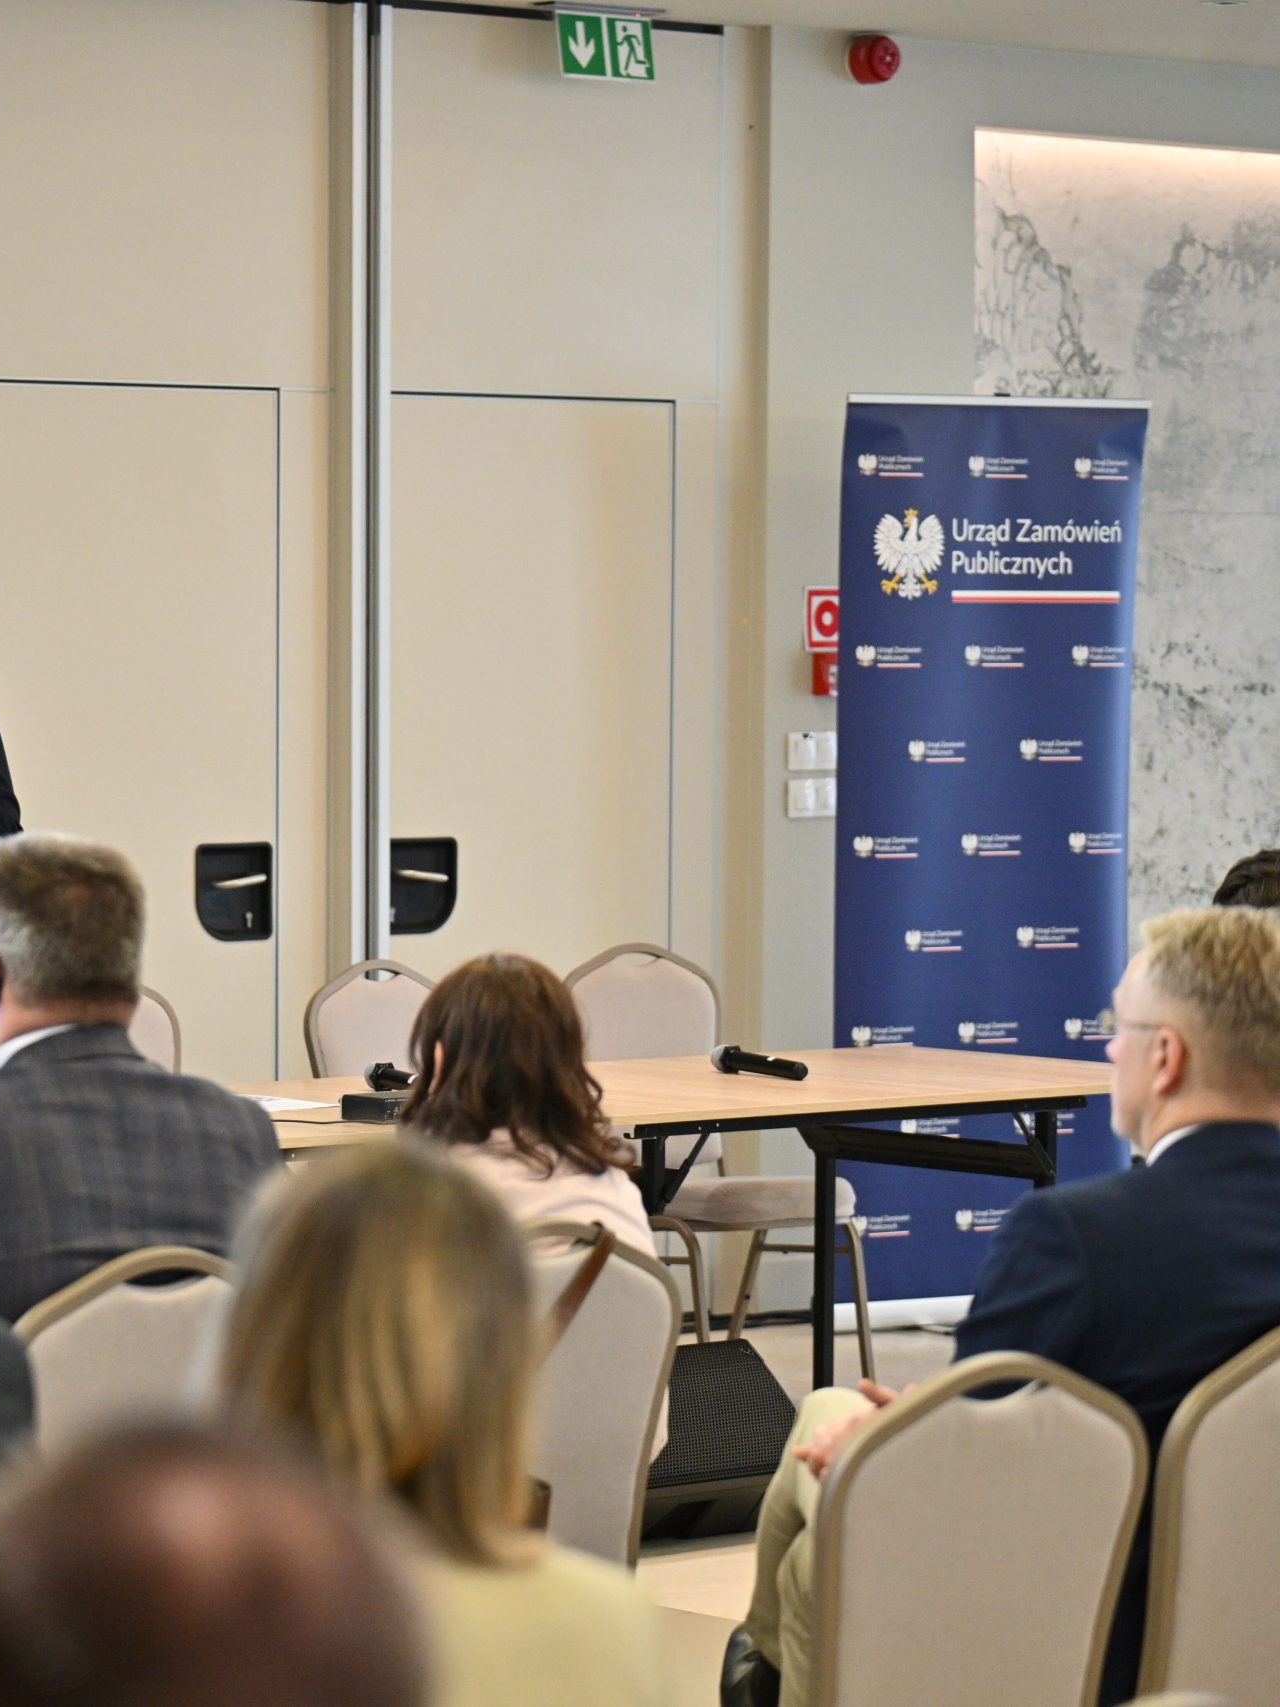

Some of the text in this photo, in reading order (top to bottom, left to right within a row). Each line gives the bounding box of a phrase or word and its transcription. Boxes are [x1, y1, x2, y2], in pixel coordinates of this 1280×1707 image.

[952, 518, 1122, 547] Urząd Zamówień
[952, 550, 1073, 579] Publicznych
